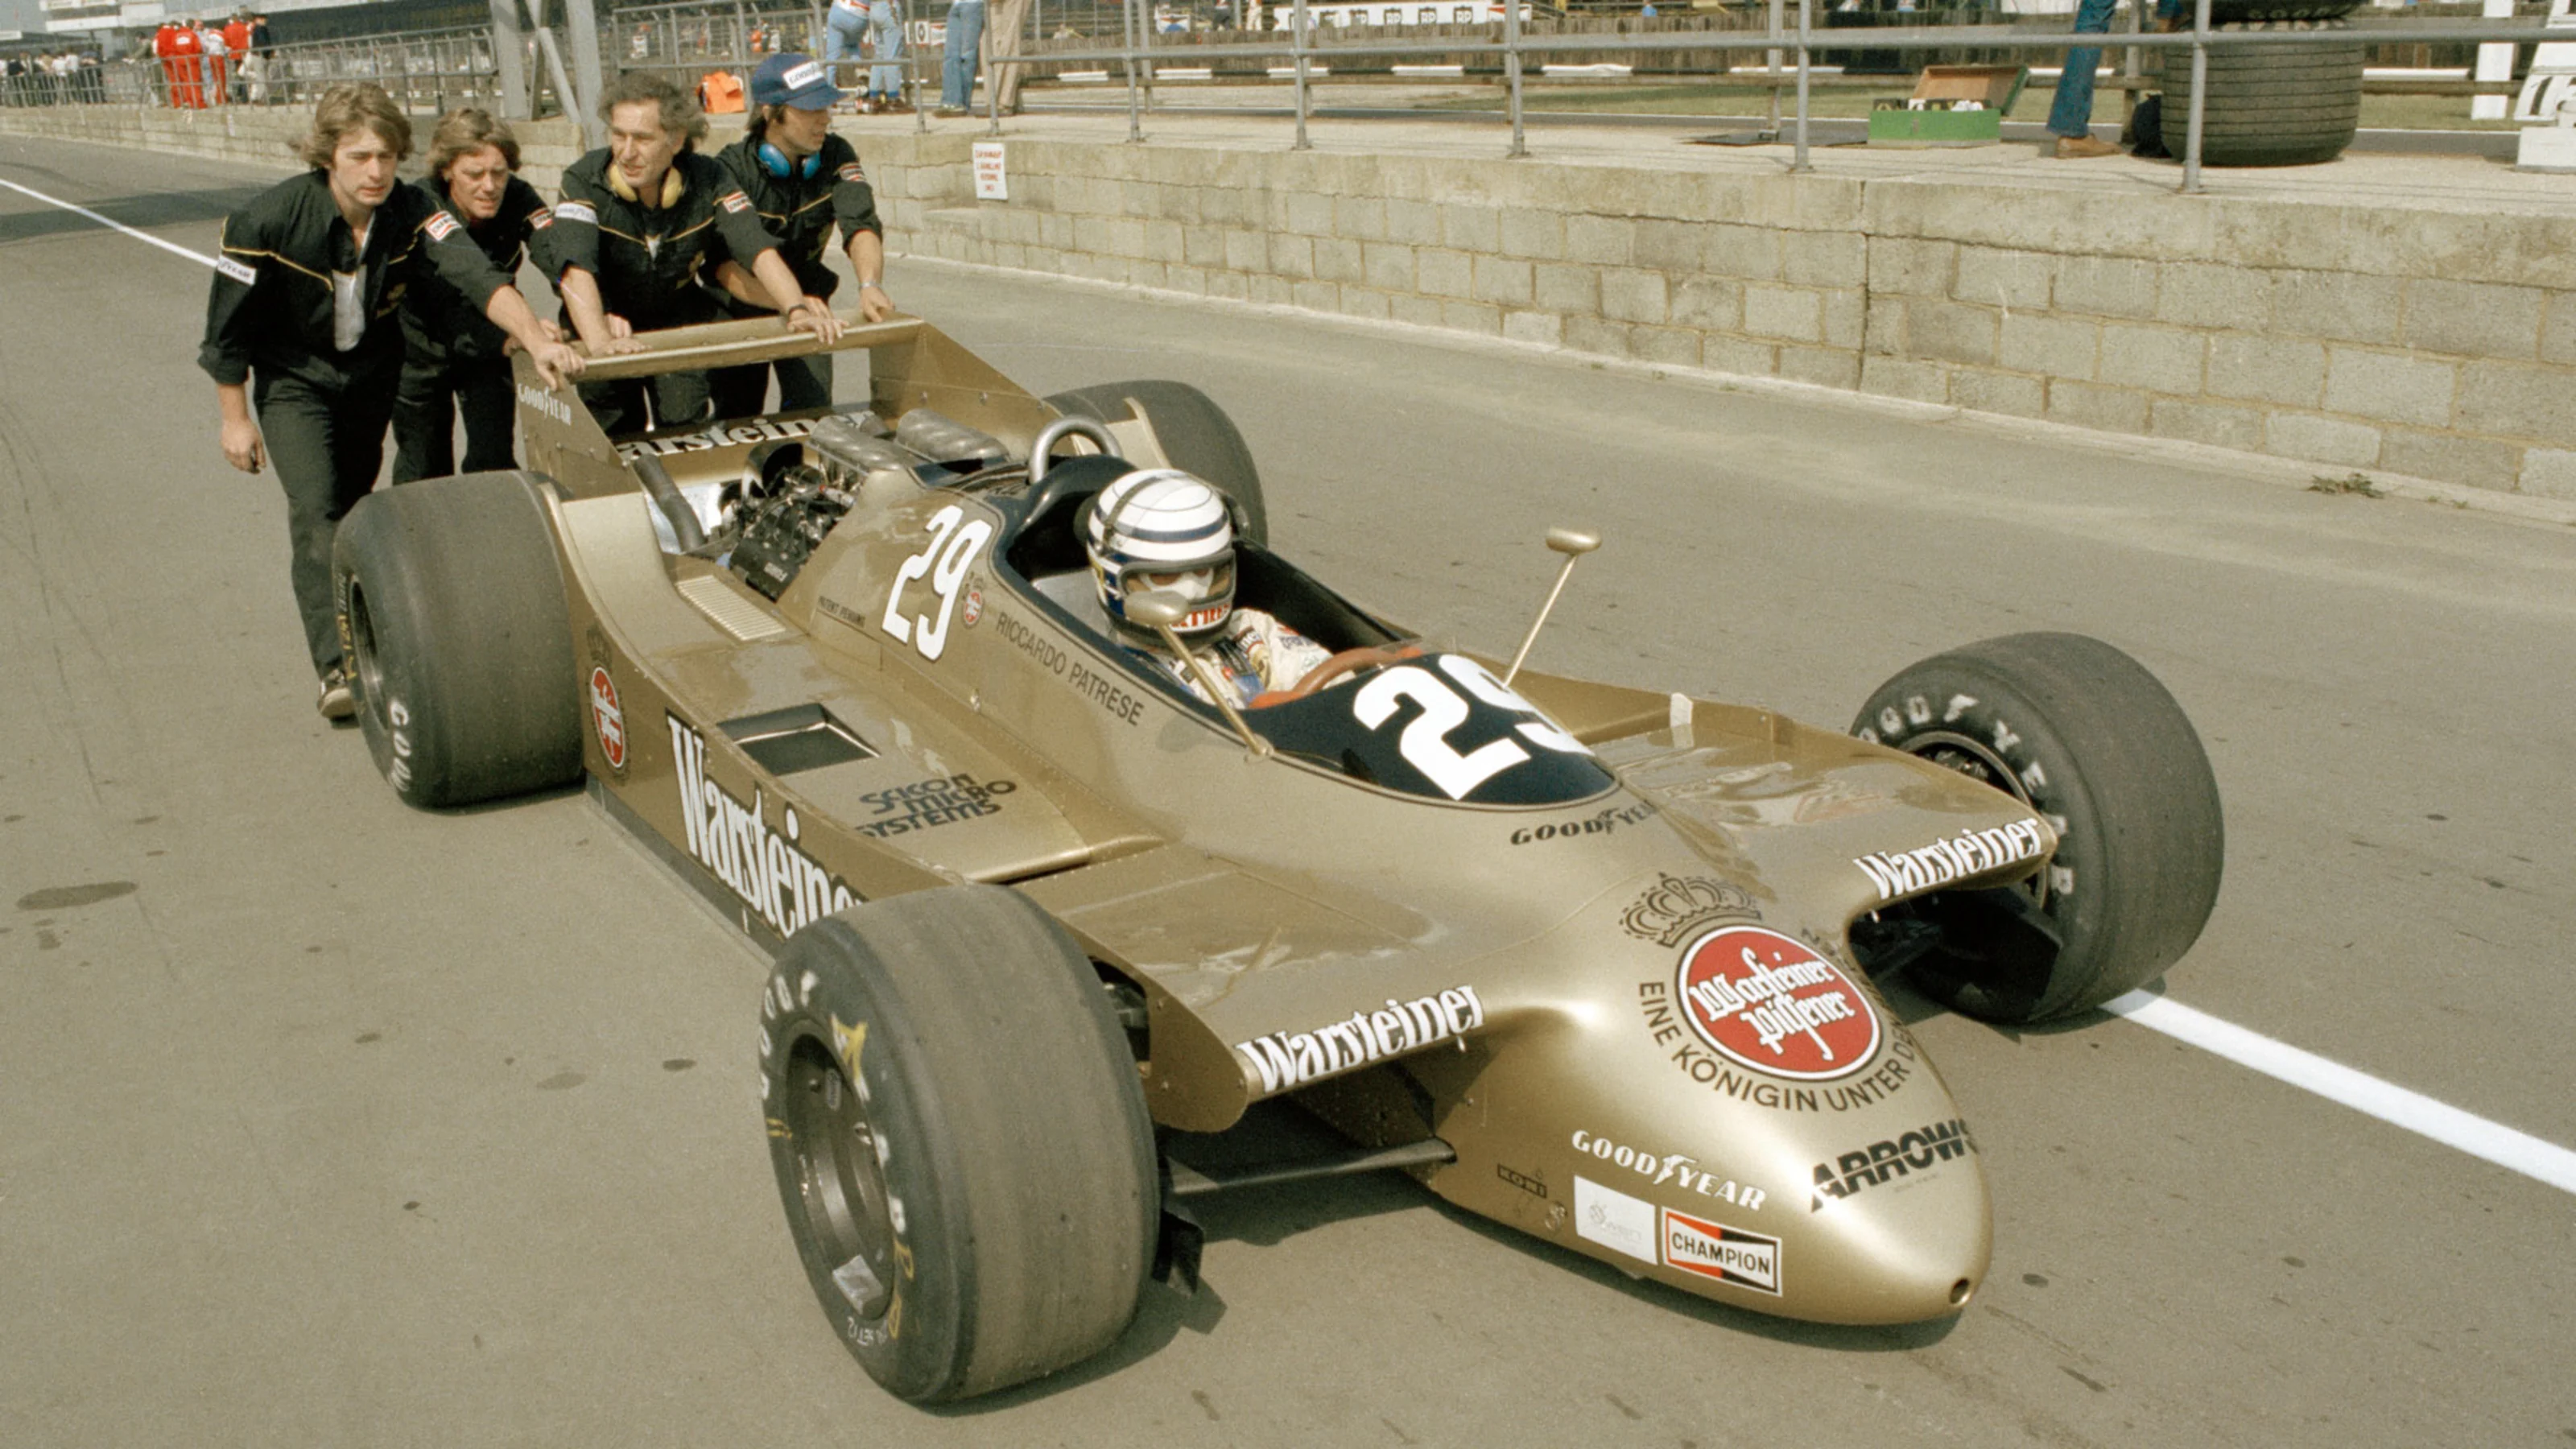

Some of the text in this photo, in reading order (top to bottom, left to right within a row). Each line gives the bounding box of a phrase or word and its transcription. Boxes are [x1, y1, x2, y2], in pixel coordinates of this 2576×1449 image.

[881, 504, 993, 662] 29
[995, 611, 1145, 726] RICCARDO PATRESE
[1853, 817, 2042, 900] Warsteiner
[1236, 985, 1484, 1093] Warsteiner
[1639, 980, 1681, 1047] EINE
[1672, 1042, 1819, 1112] KÖNIGIN
[1824, 1059, 1911, 1110] UNTER
[1571, 1129, 1768, 1212] GOODYEAR
[1670, 1232, 1772, 1276] CHAMPION
